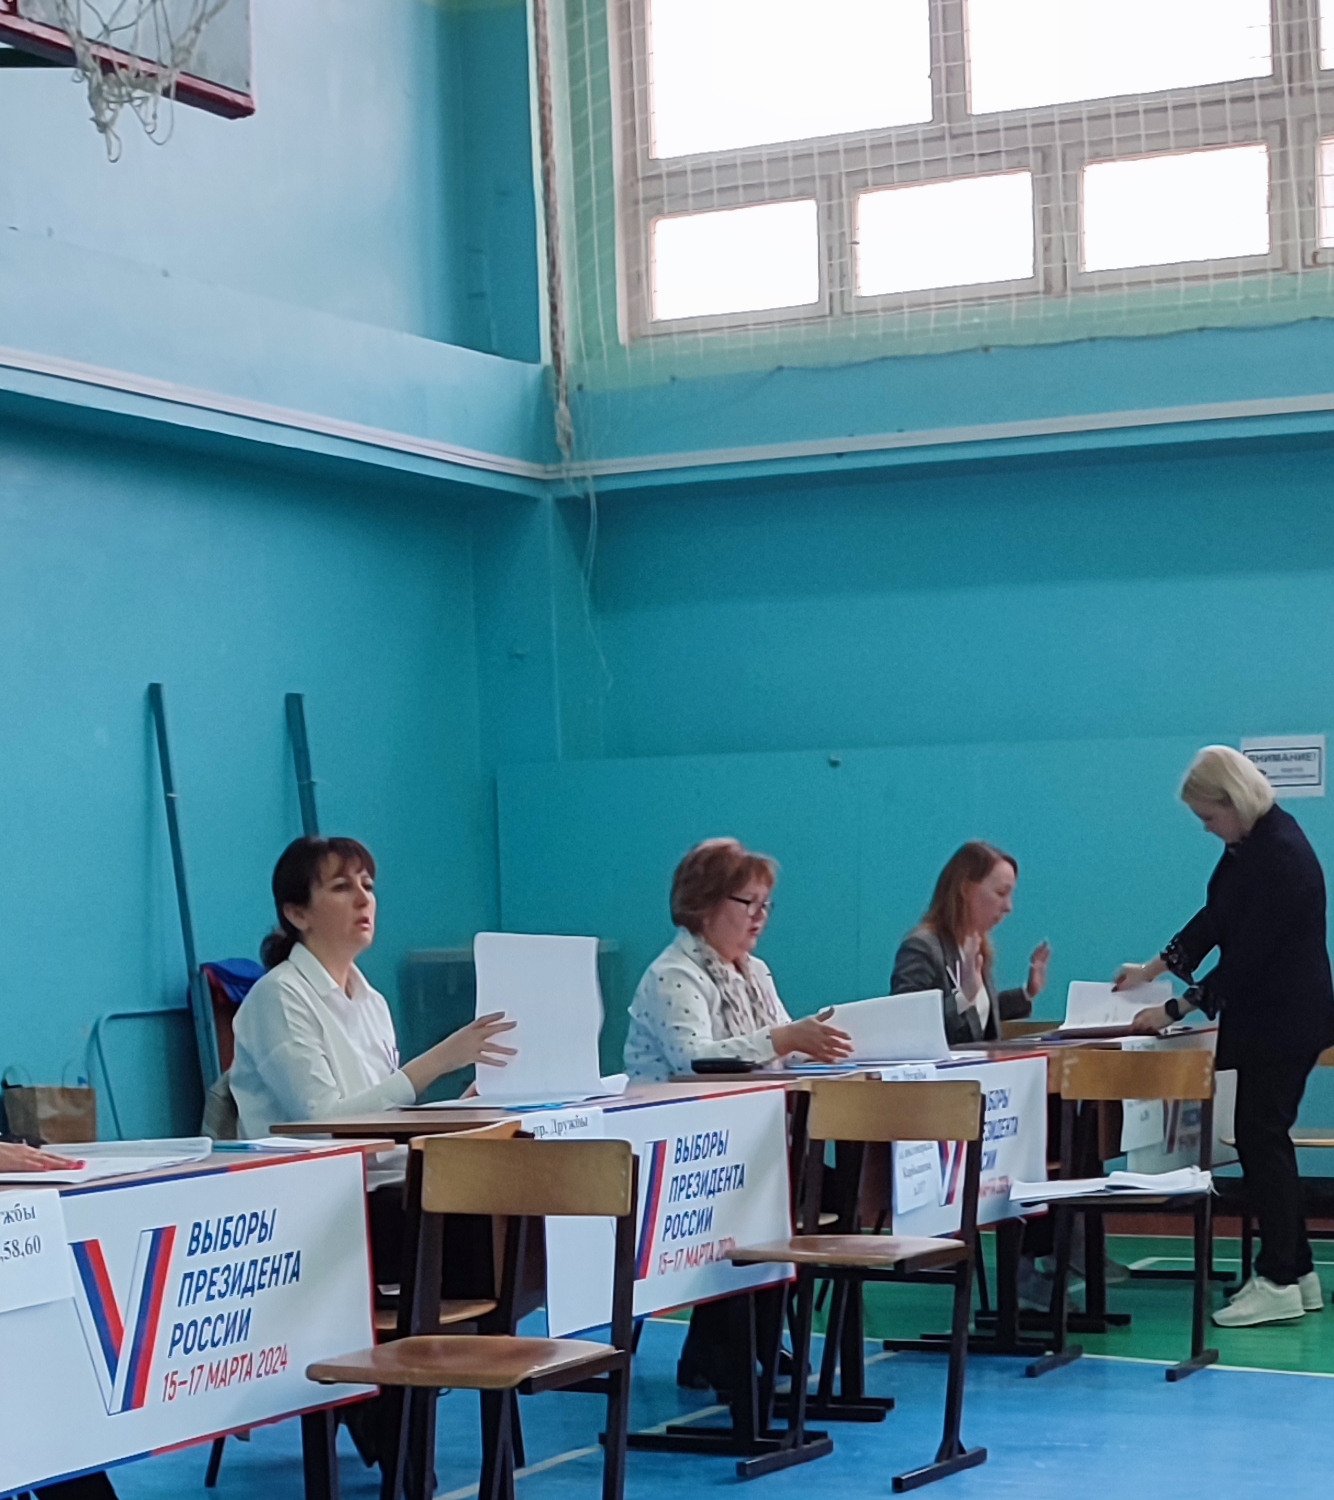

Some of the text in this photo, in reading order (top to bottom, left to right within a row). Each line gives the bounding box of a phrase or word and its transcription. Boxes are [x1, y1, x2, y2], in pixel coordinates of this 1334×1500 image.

[674, 1129, 730, 1165] ВЫБОРЫ
[668, 1163, 745, 1203] ПРЕЗИДЕНТА
[187, 1208, 277, 1257] ВЫБОРЫ
[662, 1205, 713, 1242] РОССИИ
[685, 1241, 715, 1268] МАРТА
[177, 1250, 301, 1308] ПРЕЗИДЕНТА
[168, 1307, 252, 1358] РОССИИ
[205, 1352, 253, 1392] МАРТА
[256, 1343, 288, 1378] 2024
